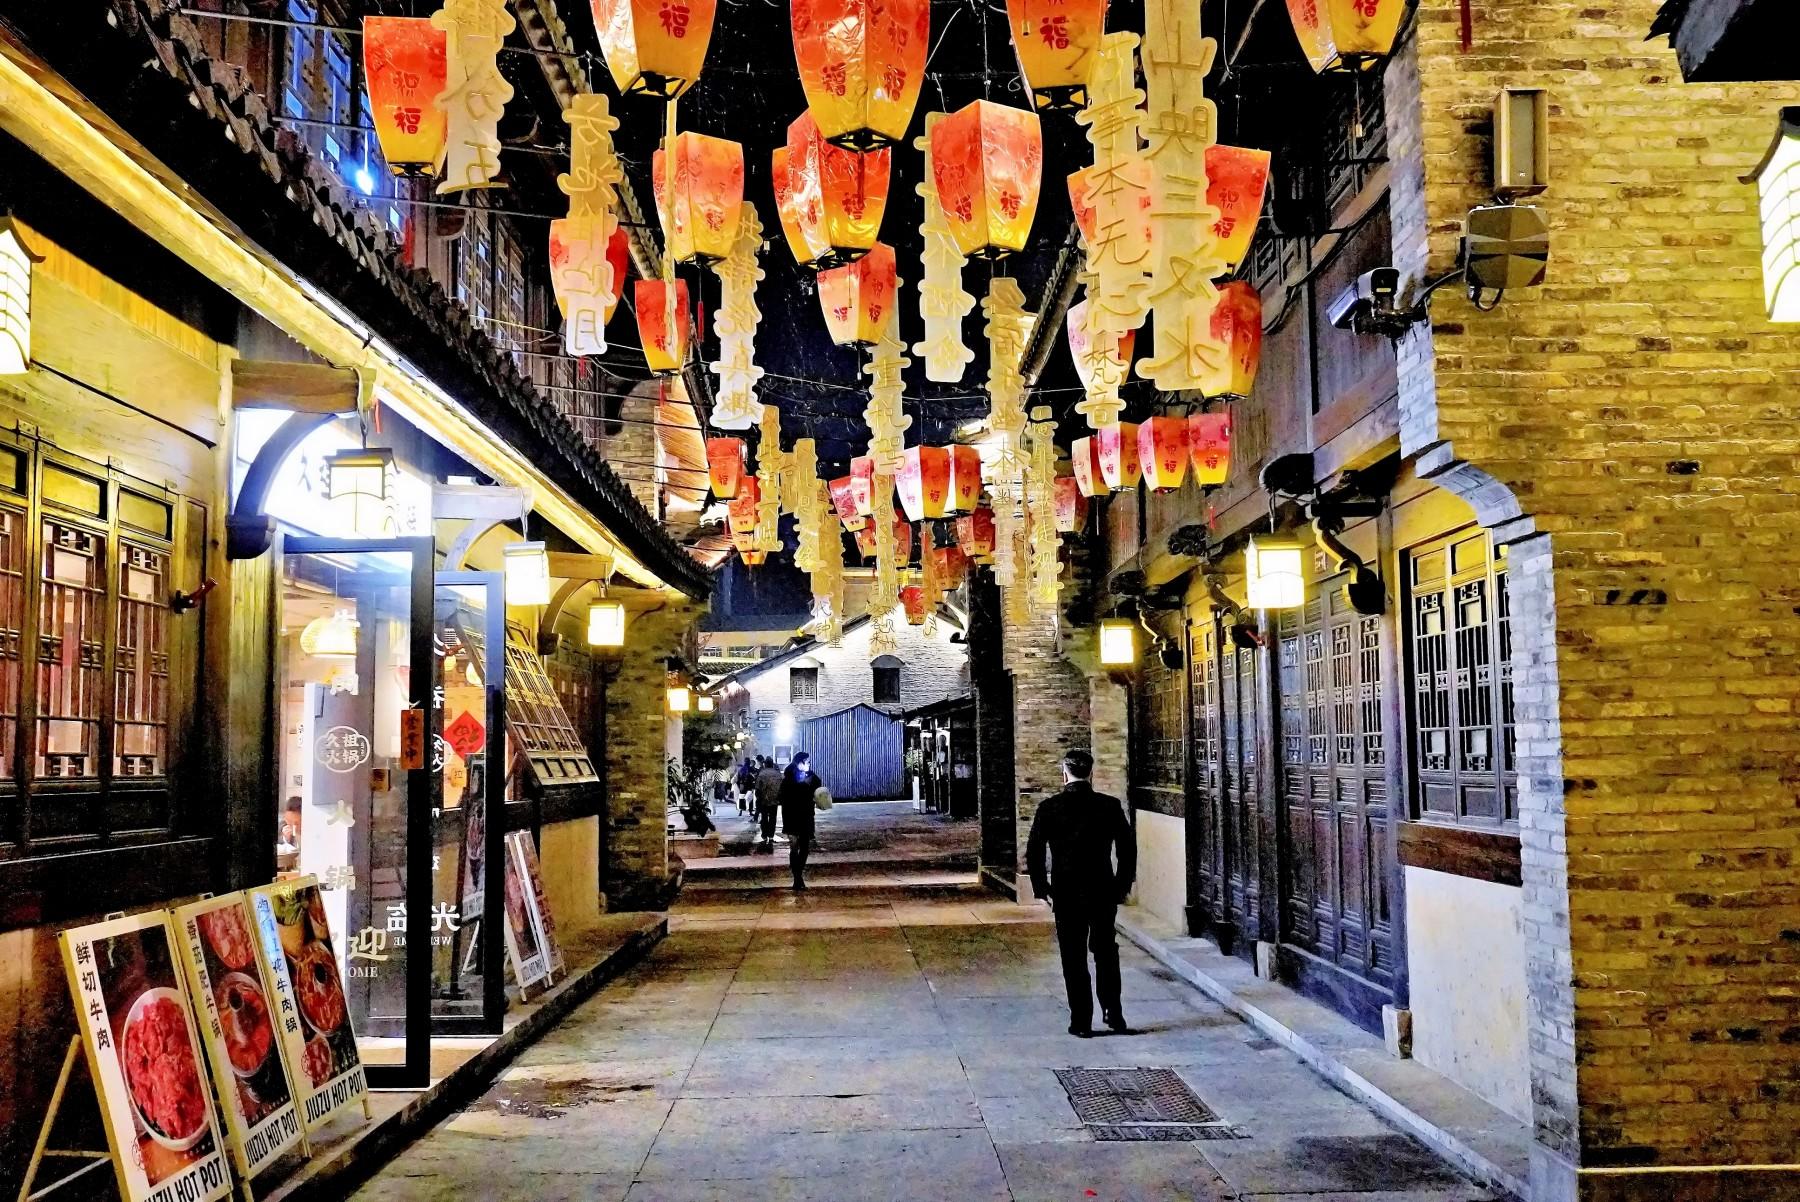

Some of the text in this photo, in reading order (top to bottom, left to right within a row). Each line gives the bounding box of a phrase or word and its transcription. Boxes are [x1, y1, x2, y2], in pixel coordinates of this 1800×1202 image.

[75, 942, 111, 1051] 鲜切牛肉
[305, 1070, 364, 1124] JIUZU HOT POT
[266, 1123, 285, 1152] HOT
[283, 1107, 299, 1139] POT
[174, 1169, 200, 1202] HOT
[199, 1156, 224, 1194] POT
